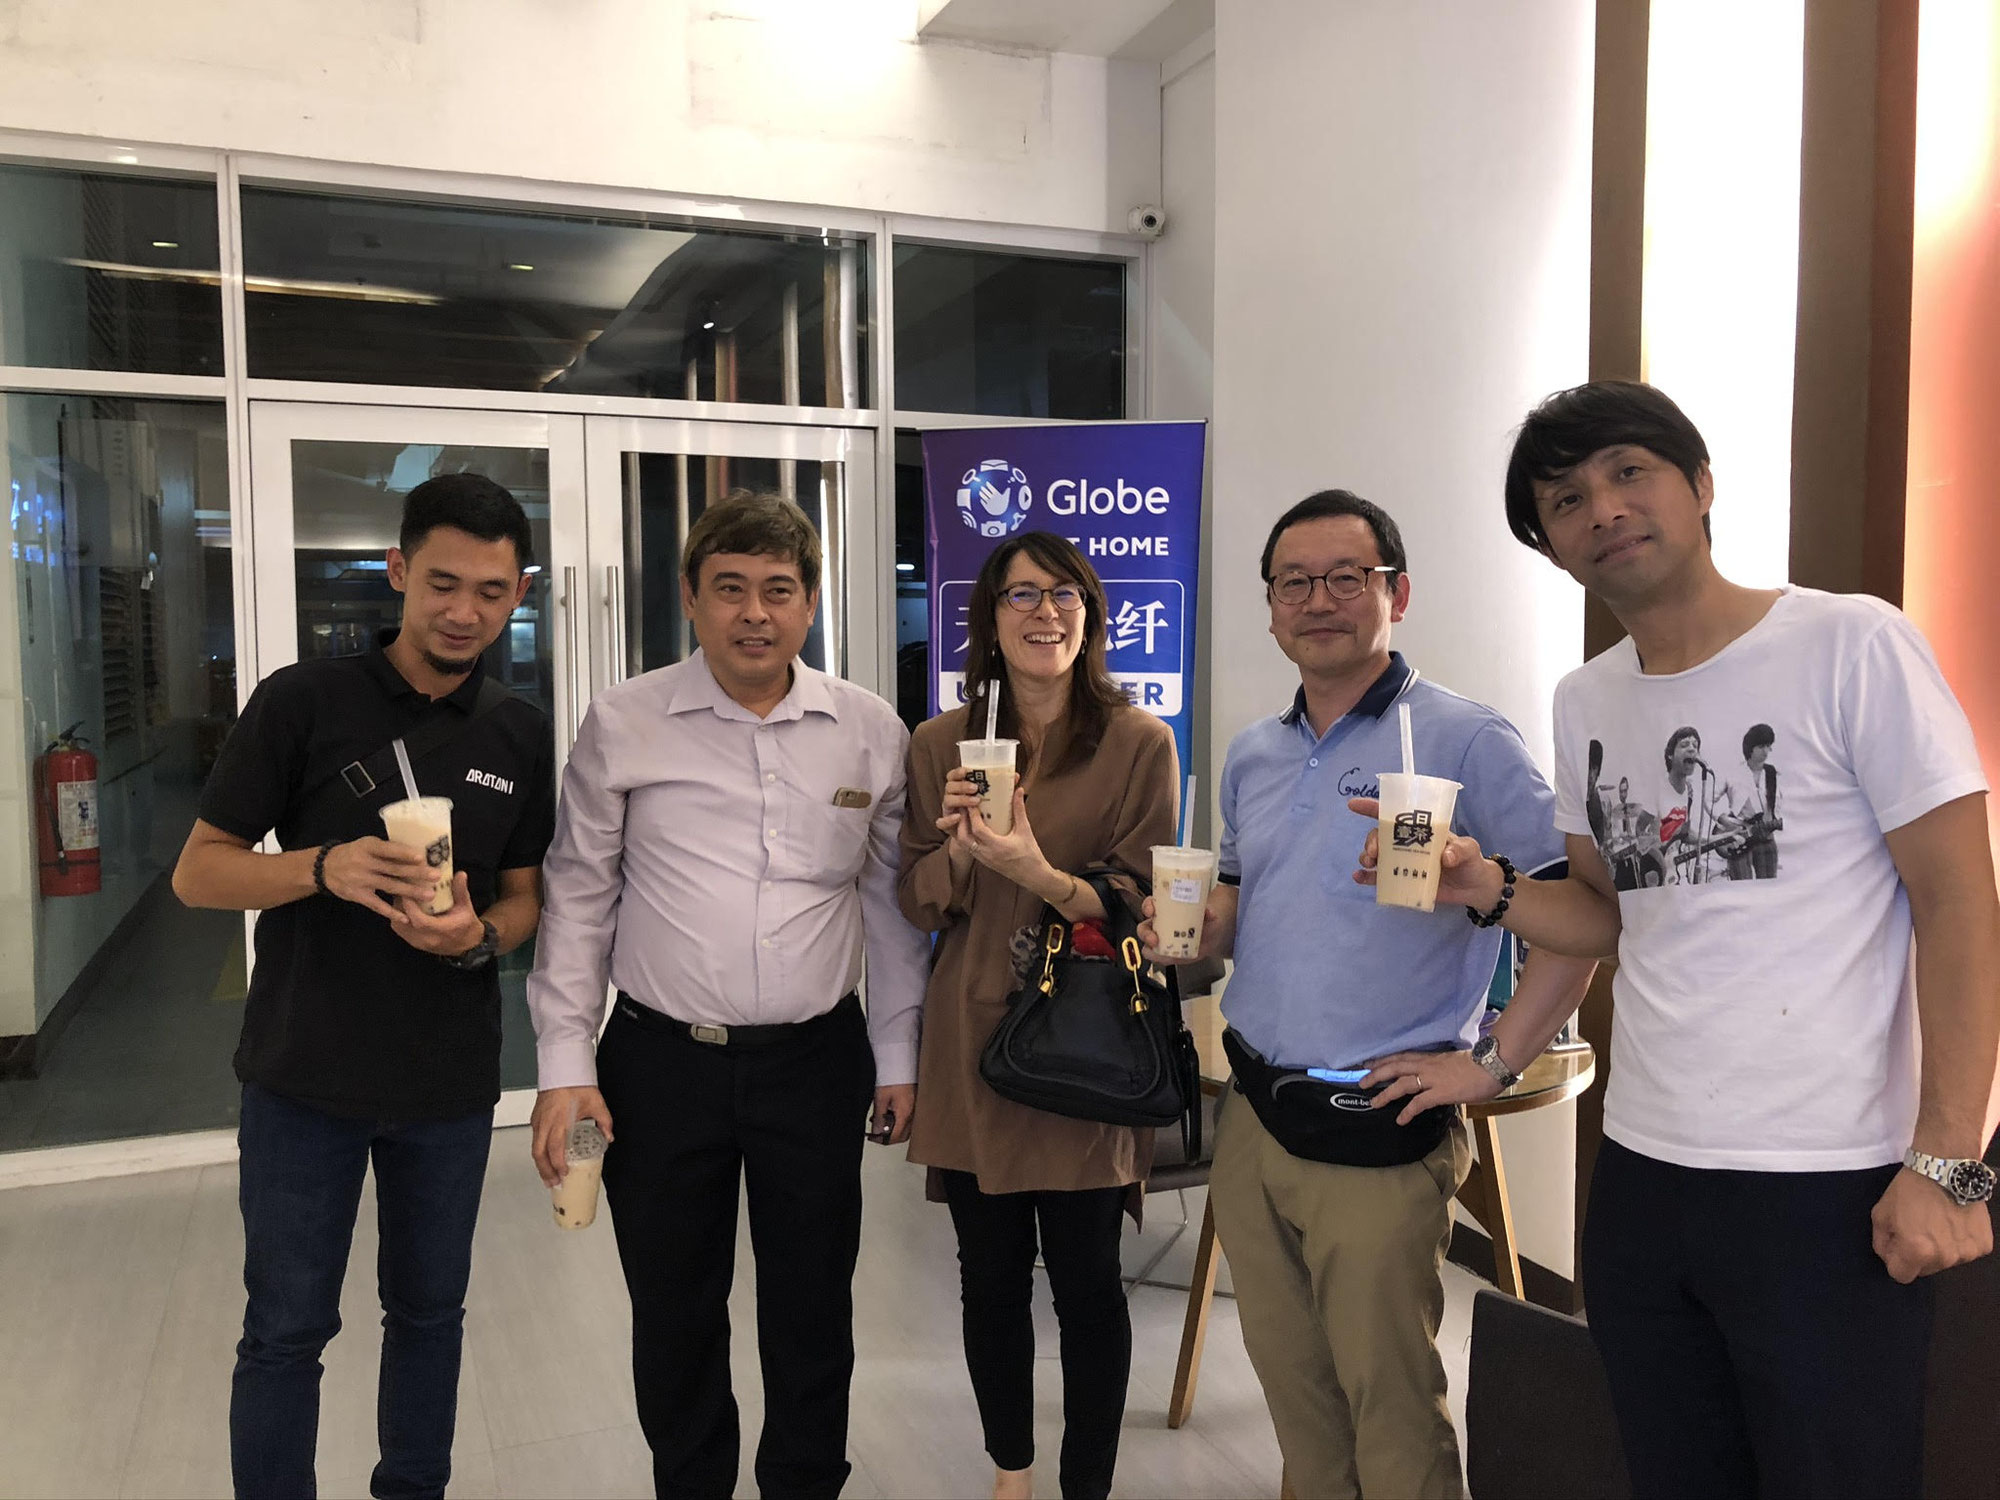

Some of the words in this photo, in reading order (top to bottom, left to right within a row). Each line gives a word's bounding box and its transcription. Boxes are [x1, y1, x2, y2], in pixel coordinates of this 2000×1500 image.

[1047, 479, 1170, 515] Globe
[1089, 537, 1169, 556] HOME
[466, 769, 514, 794] ARATANI
[1338, 1098, 1371, 1106] mont-be
